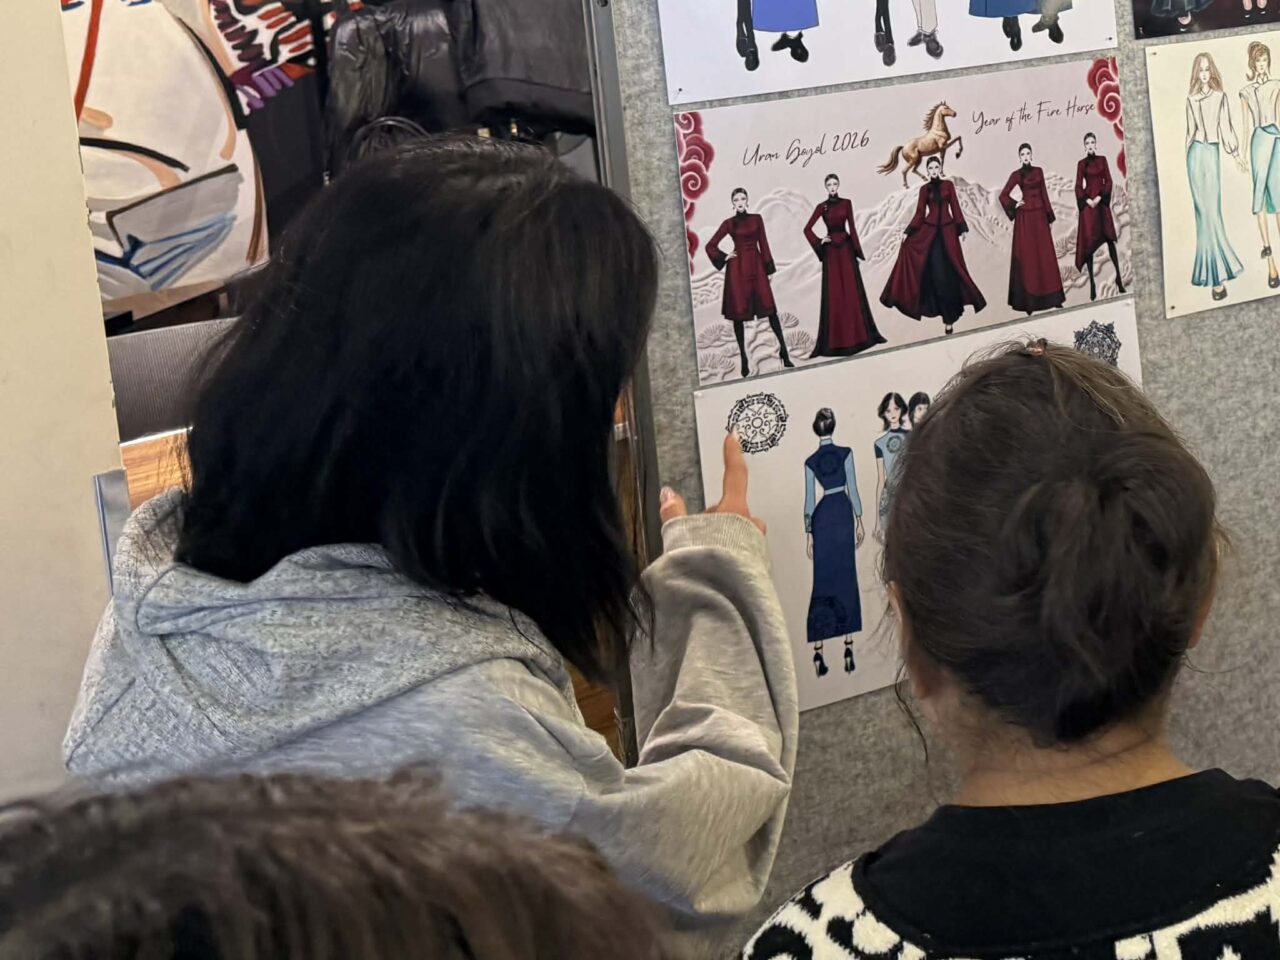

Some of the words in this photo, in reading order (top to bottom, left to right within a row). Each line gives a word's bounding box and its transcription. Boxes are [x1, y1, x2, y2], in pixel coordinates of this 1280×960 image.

[972, 109, 1001, 135] Year
[1005, 112, 1016, 132] of
[1014, 101, 1033, 126] the
[1037, 100, 1062, 124] Fire
[1065, 95, 1096, 119] Horse
[742, 142, 781, 167] Uran
[831, 129, 870, 152] 2026
